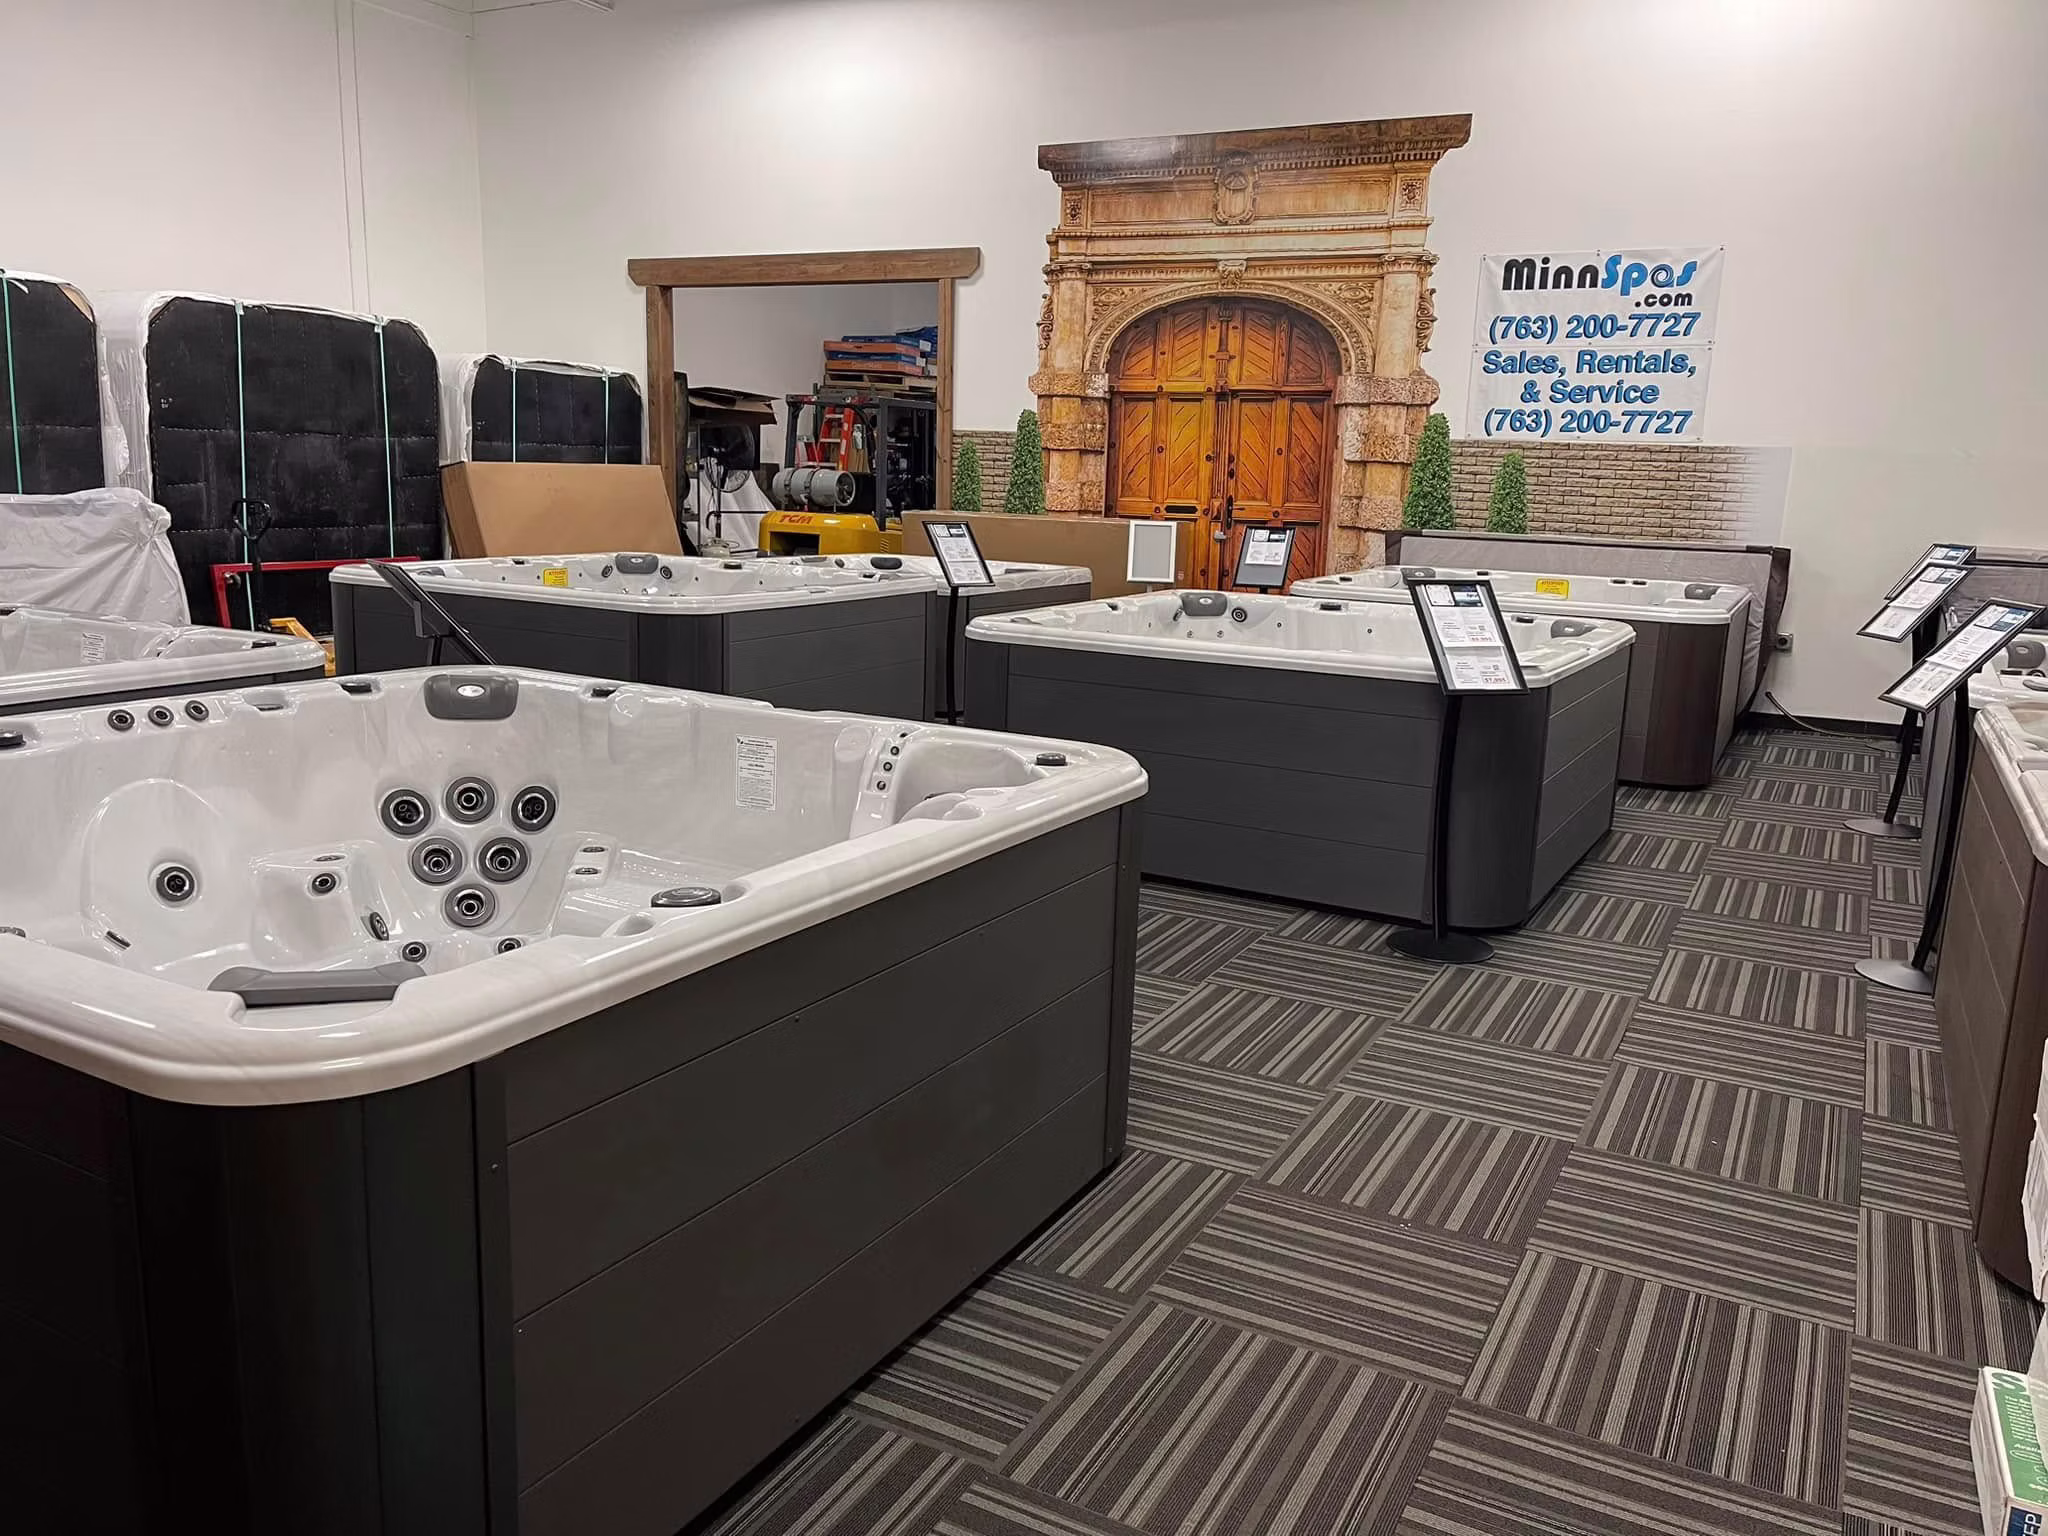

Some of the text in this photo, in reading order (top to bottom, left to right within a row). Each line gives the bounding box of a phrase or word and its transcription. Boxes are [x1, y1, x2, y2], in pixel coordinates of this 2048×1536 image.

[1502, 254, 1698, 296] MinnSpas
[1634, 293, 1693, 308] .com
[1489, 312, 1701, 345] (763) 200-7727
[1482, 349, 1697, 378] Sales, Rentals,
[1520, 379, 1660, 404] & Service
[1484, 408, 1693, 437] (763) 200-7727
[779, 514, 813, 525] TCM
